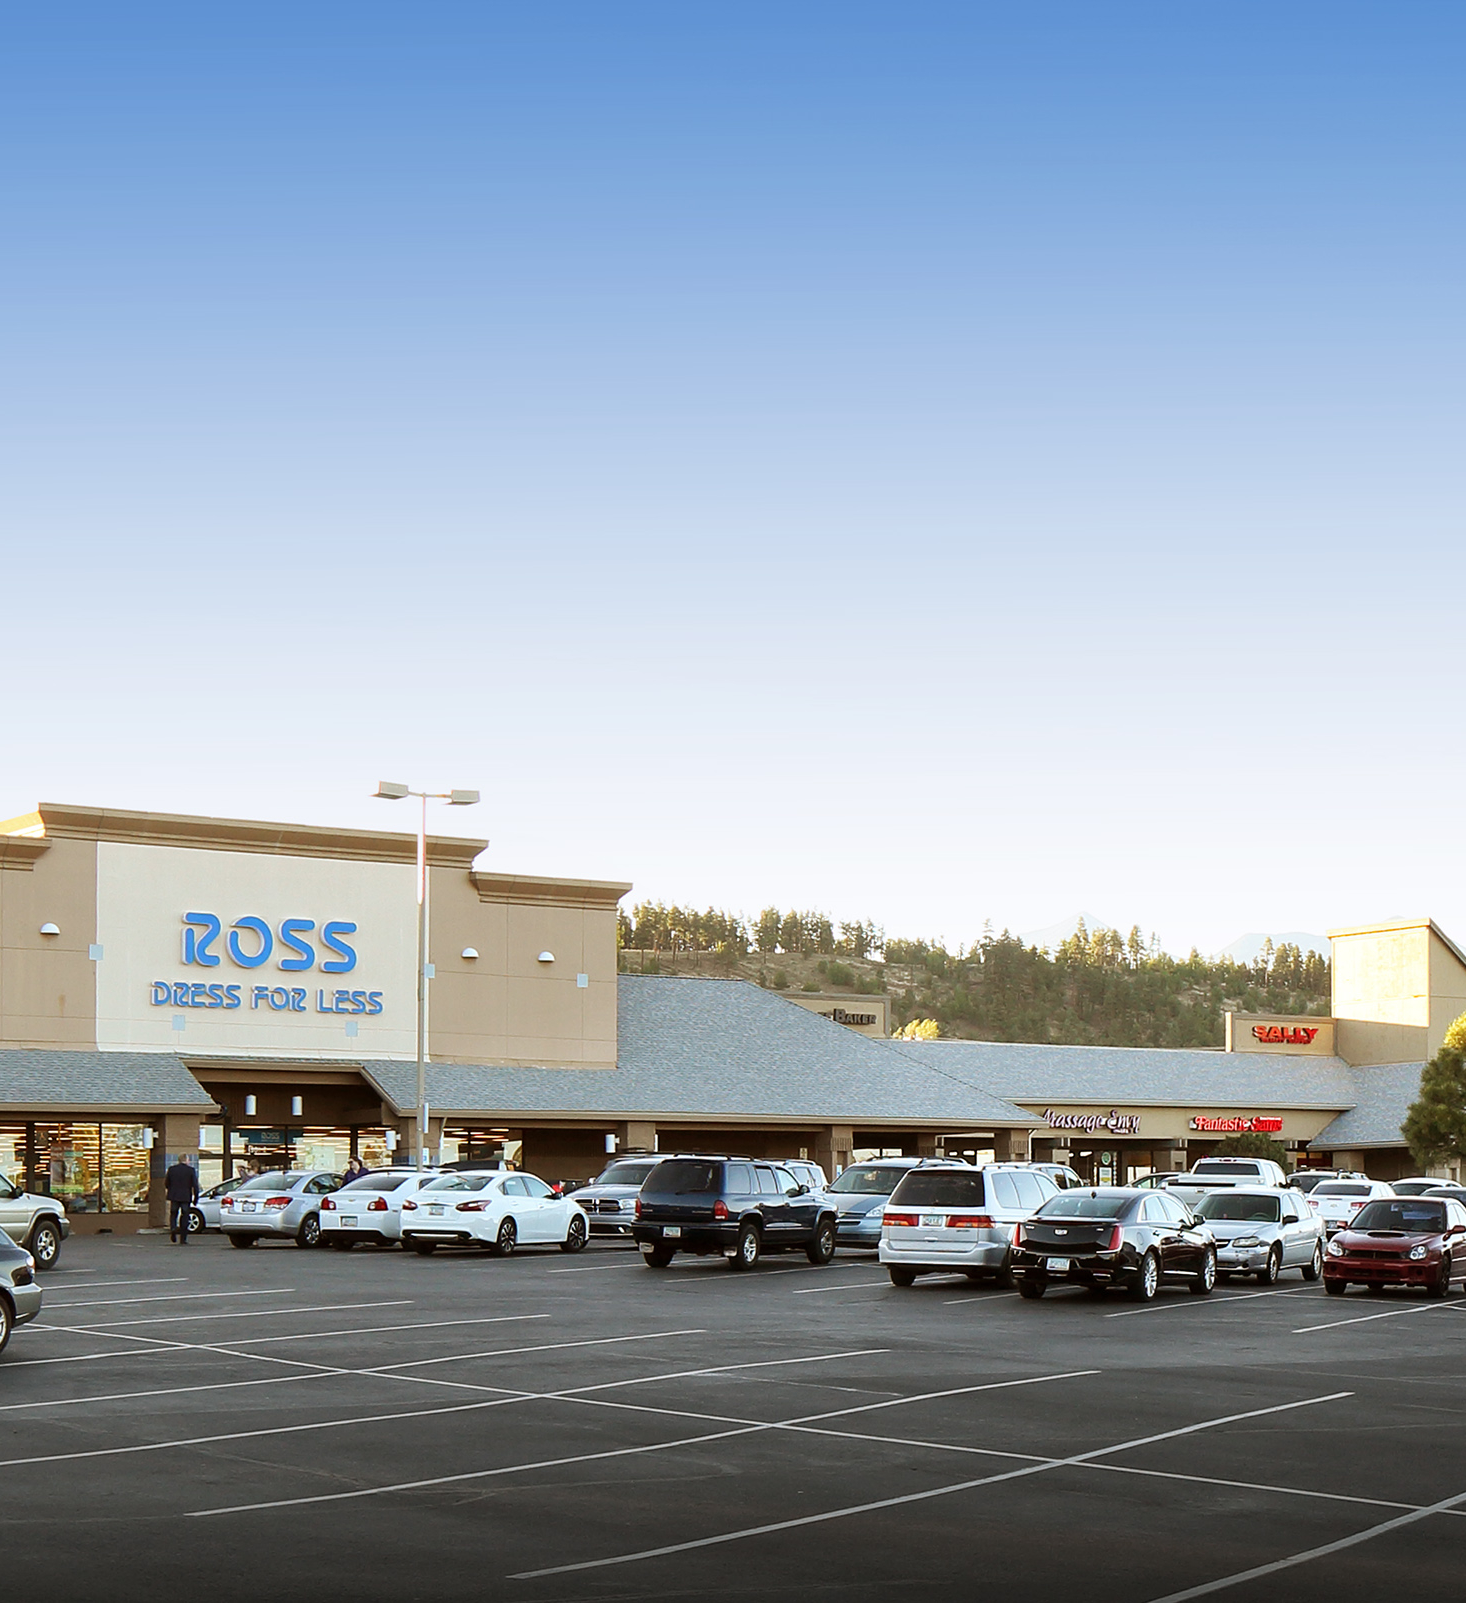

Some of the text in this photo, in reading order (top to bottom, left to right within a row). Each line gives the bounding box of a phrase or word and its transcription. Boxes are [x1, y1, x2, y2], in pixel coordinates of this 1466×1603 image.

[183, 911, 357, 973] ROSS
[151, 981, 384, 1014] DRESS FOR LESS
[1252, 1025, 1319, 1039] SALLY
[1043, 1108, 1140, 1133] Massage Envy
[1195, 1115, 1249, 1131] Fantastic
